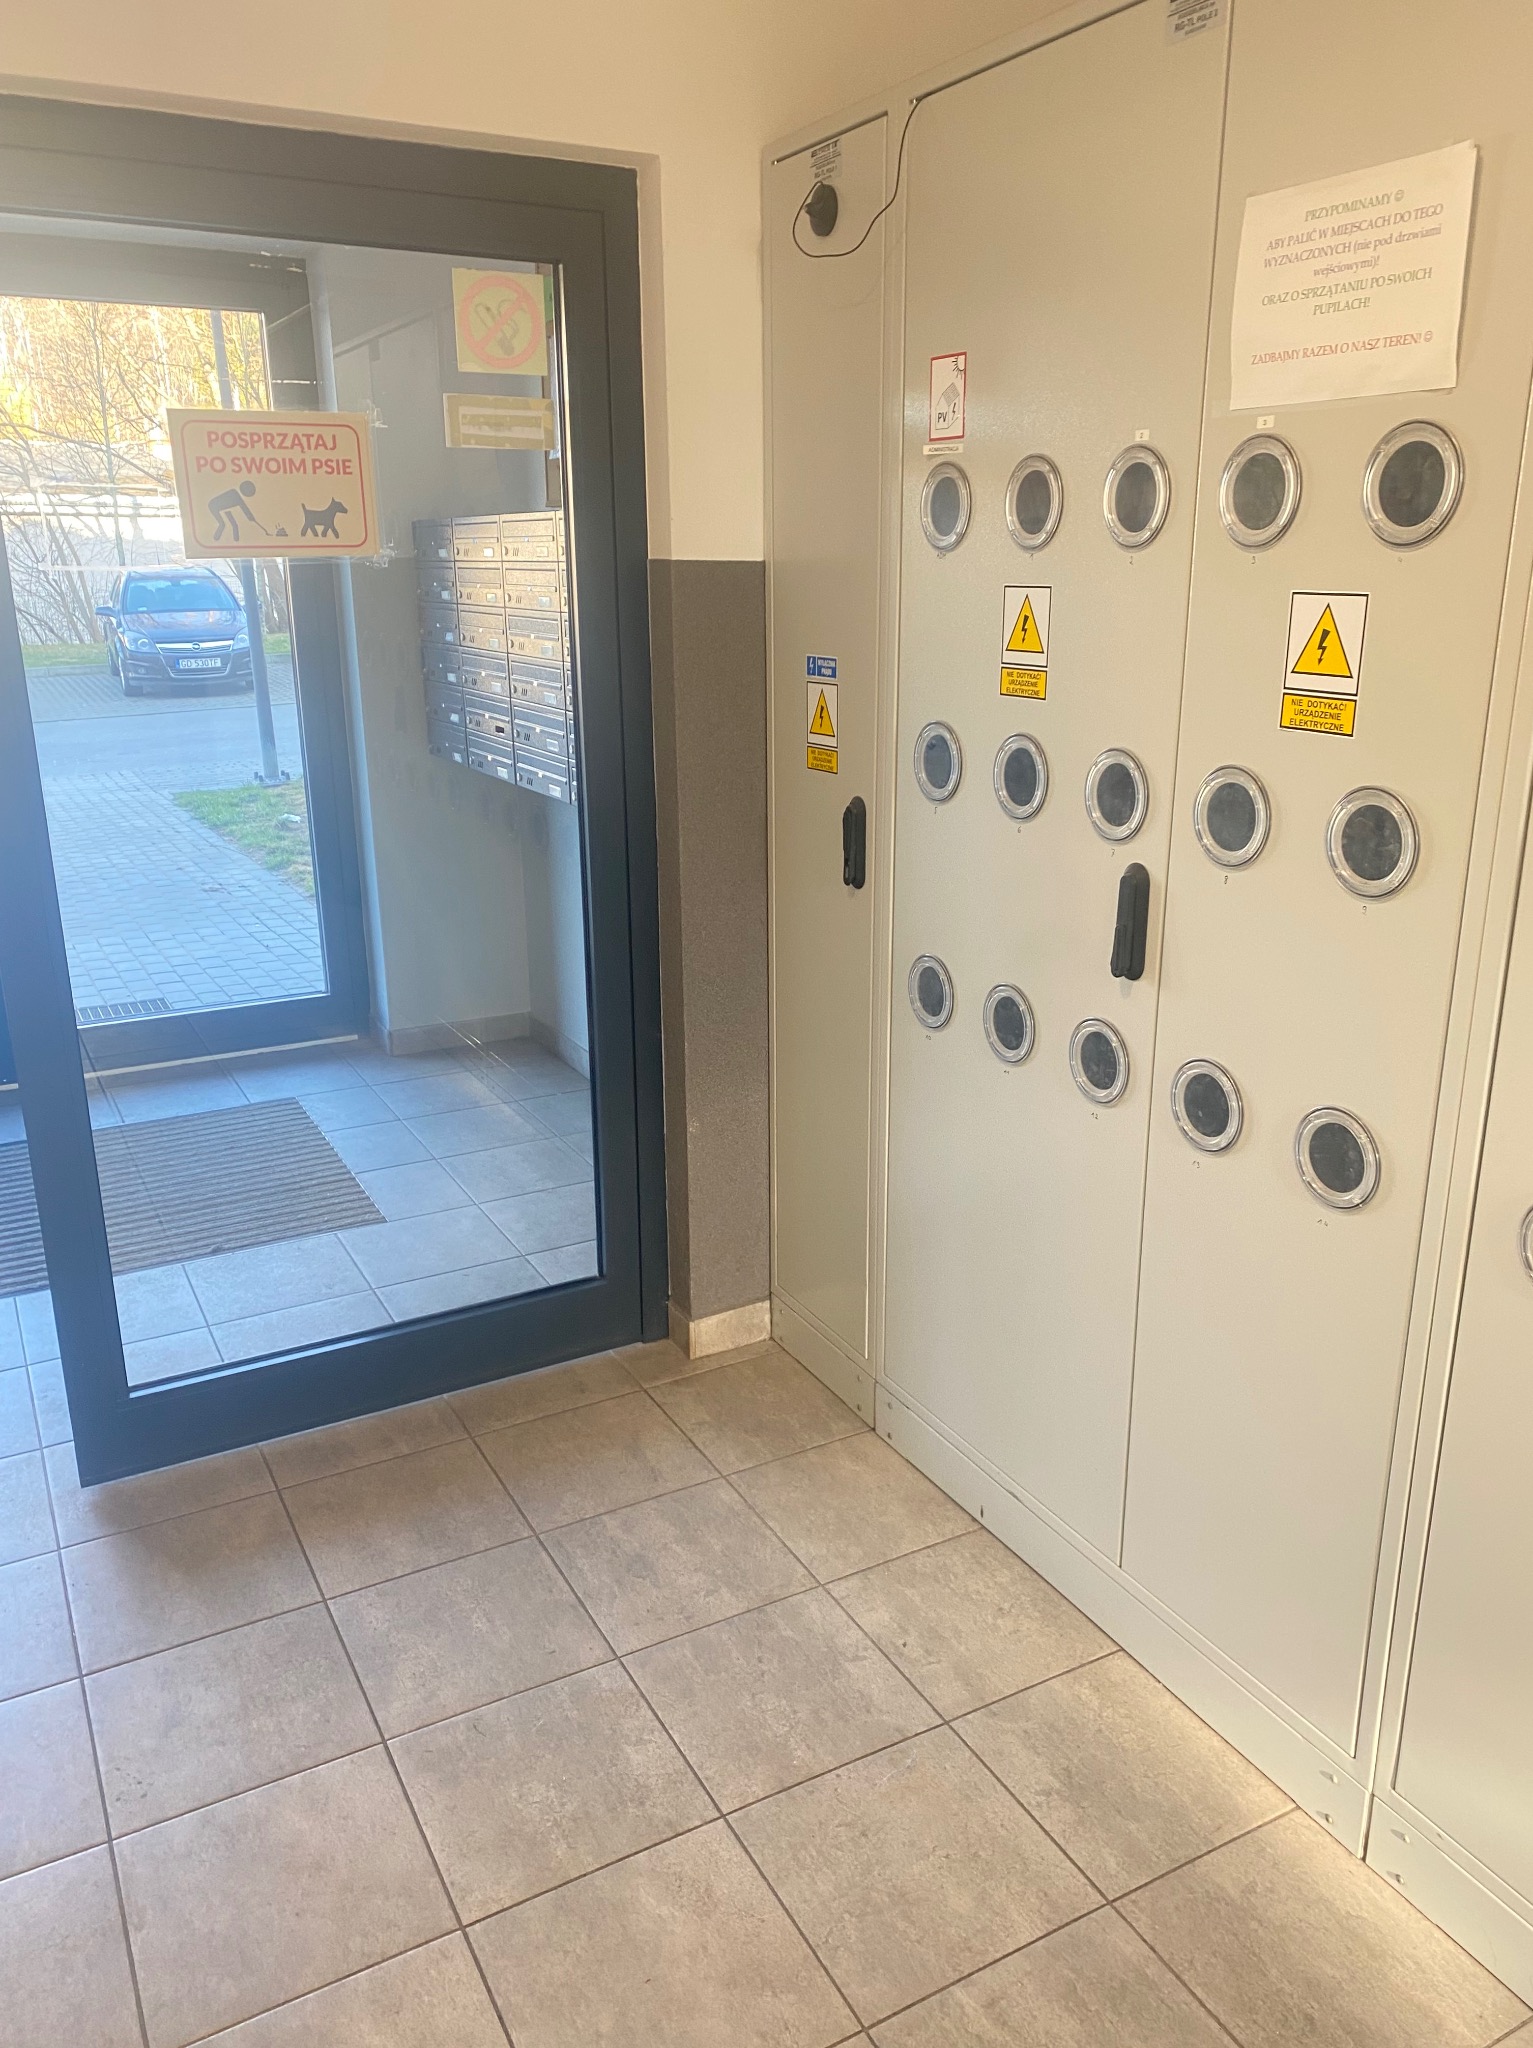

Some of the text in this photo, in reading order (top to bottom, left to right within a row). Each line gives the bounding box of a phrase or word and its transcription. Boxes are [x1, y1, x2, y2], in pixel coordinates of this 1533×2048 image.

[1304, 193, 1392, 221] PRZYPOMINAMY
[1267, 203, 1444, 251] ABY PALIĆ W MIEJSCACH DO TEGO
[1264, 223, 1442, 269] WYZNACZONYCH (nie pod drzwiami
[1261, 266, 1433, 306] ORAZ O SPRZĄTANIU PO SWOICH
[1251, 348, 1302, 365] ZADBAJMY
[1302, 343, 1340, 359] RAZEM
[1340, 342, 1350, 355] O
[1350, 337, 1381, 352] NASZ
[937, 411, 948, 423] PV
[206, 430, 338, 454] POSPRZĄTAJ
[195, 455, 353, 476] PO SWOIM PSIE
[181, 659, 192, 669] GD
[1016, 672, 1042, 680] DOTYKAĆ!
[1008, 679, 1039, 688] URZĄDZENIE
[1006, 687, 1040, 696] ELEKTRYCZNE
[1291, 698, 1347, 711] NIE DOTYKAĆ!
[1294, 708, 1342, 721] URZĄDZENIE
[1289, 718, 1344, 731] ELEKTRYCZNE
